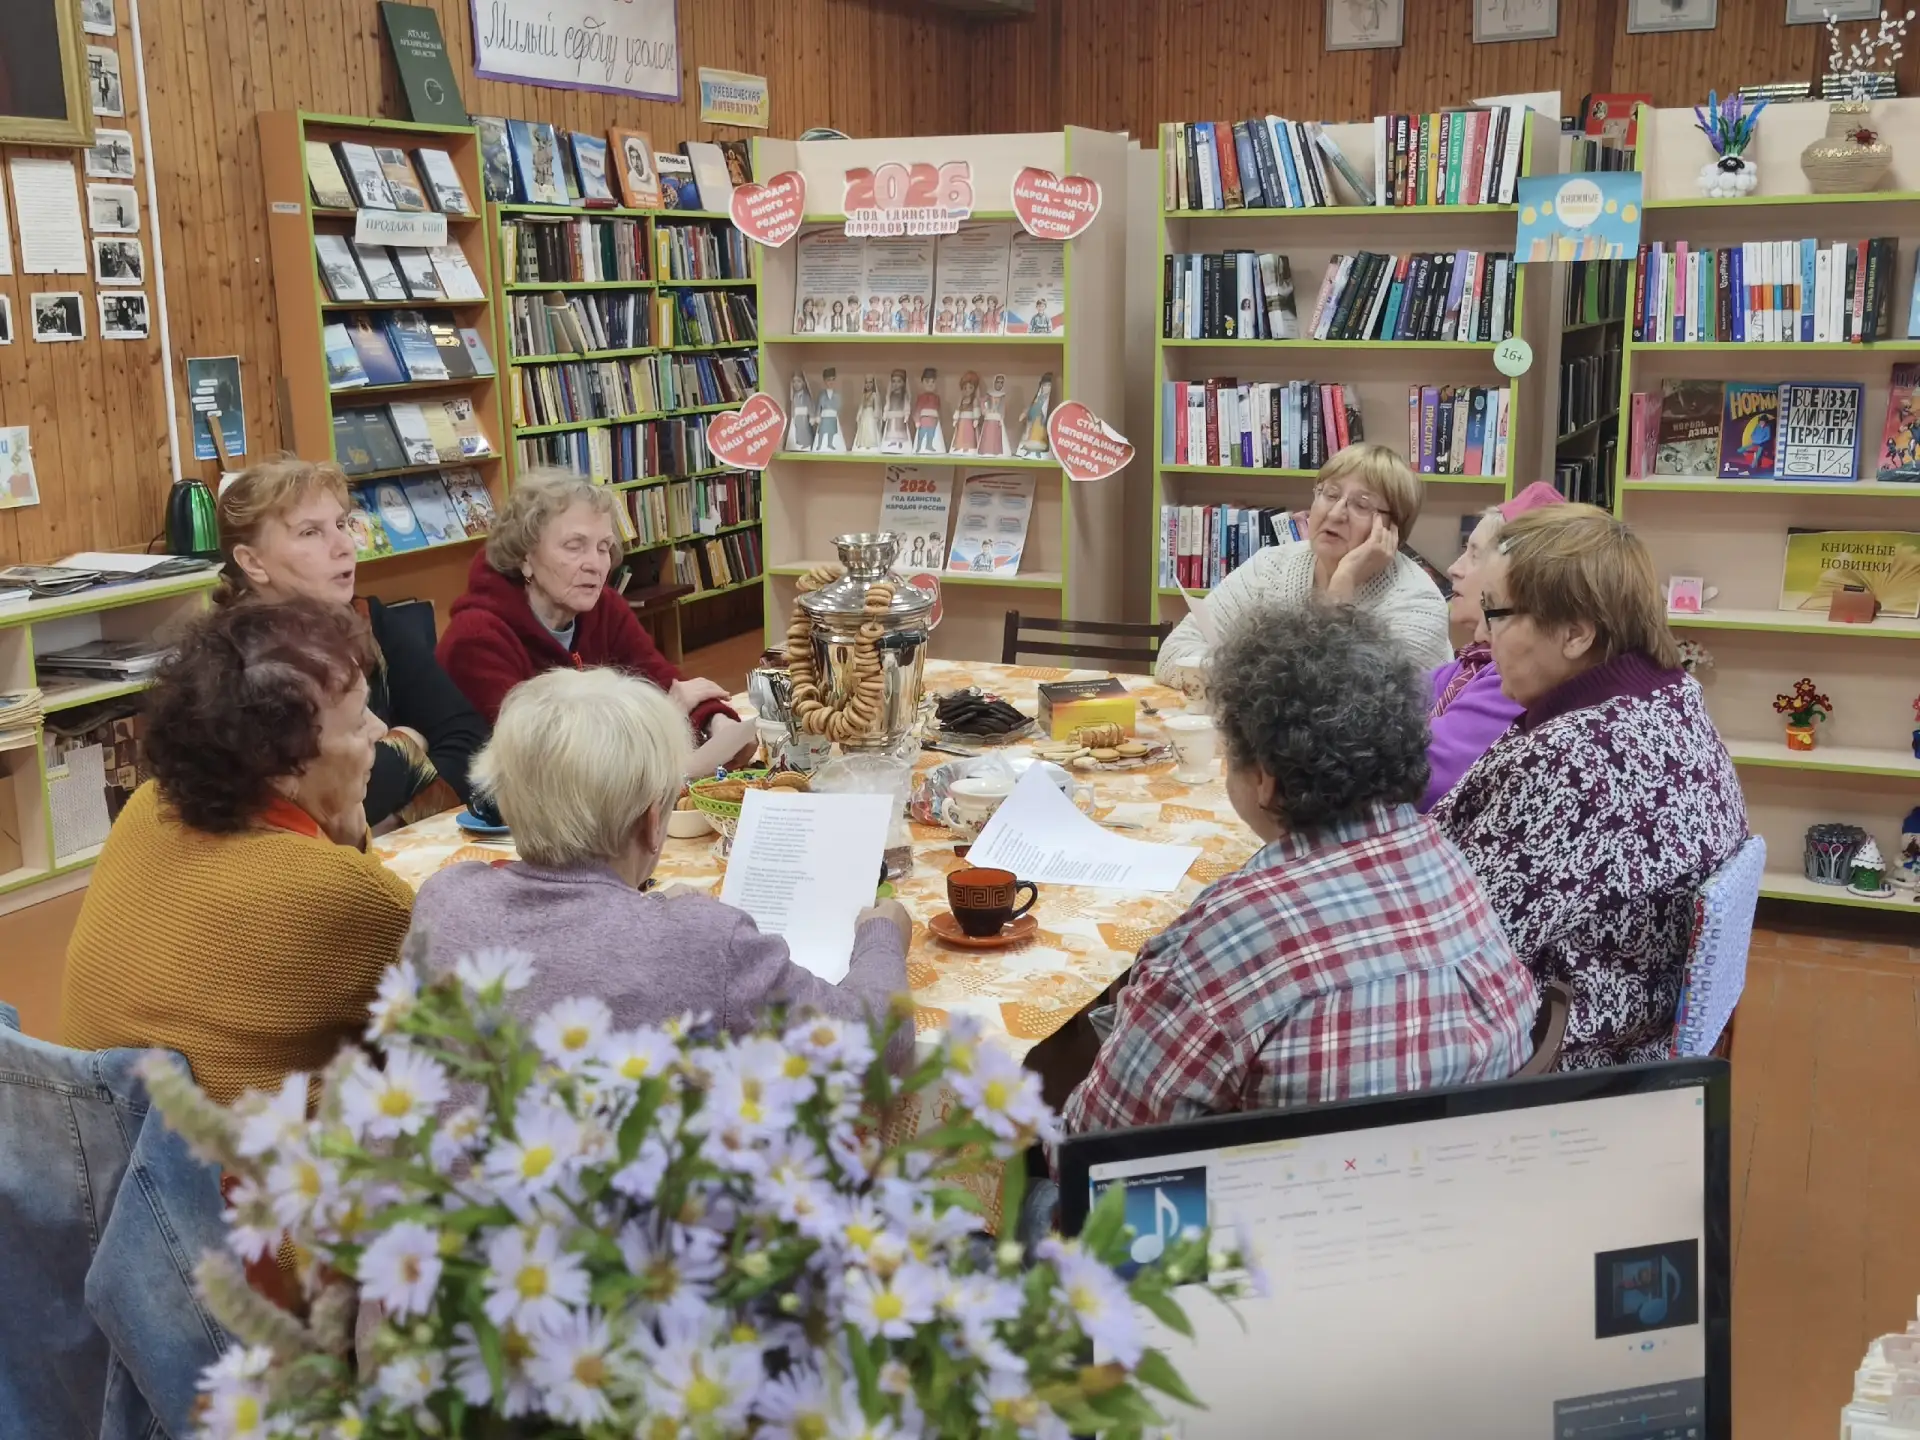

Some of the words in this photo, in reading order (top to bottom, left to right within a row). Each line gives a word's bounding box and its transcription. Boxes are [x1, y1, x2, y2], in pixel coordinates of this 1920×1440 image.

[484, 0, 558, 57] Милый
[564, 16, 618, 82] сердцу
[625, 36, 675, 83] уголок
[1397, 120, 1407, 152] ПЕТЛЯ
[1420, 121, 1429, 147] ОЛЕГ
[1441, 116, 1449, 141] ТРАУБ
[1453, 116, 1462, 140] ТРАУБ
[1409, 128, 1418, 150] ДЕНЬ
[1420, 148, 1428, 171] РОЙ
[1439, 142, 1448, 166] МАША
[1451, 141, 1460, 165] МАША
[1407, 151, 1417, 188] СЧАСТЬЯ
[746, 182, 791, 206] НАРОДОВ
[845, 161, 972, 211] 2026
[1034, 178, 1082, 196] КАЖДЫЙ
[751, 199, 783, 218] МНОГО
[1015, 187, 1050, 204] НАРОД
[1063, 197, 1096, 213] ЧАСТЬ
[1560, 193, 1599, 205] КНИЖНЫЕ
[755, 208, 796, 229] РОДИНА
[857, 209, 878, 221] ГОД
[886, 208, 948, 220] ЕДИНСТВА
[1031, 204, 1076, 222] ВЕЛИКОЙ
[366, 218, 415, 232] ПРОДАЖА
[767, 222, 795, 239] ОДНА
[847, 222, 903, 234] НАРОДОВ
[909, 221, 957, 233] РОССИИ
[1030, 217, 1071, 233] РОССИИ
[1502, 347, 1524, 362] 16+
[720, 411, 759, 438] РОССИЯ
[1790, 408, 1856, 427] МИСТЕРА
[720, 435, 744, 454] НАШ
[745, 411, 781, 439] ОБЩИЙ
[1423, 405, 1434, 457] ПРИСЛУГА
[1688, 425, 1720, 438] ДЗЮДО
[1788, 426, 1854, 446] ТЕРРАПТА
[746, 436, 768, 456] ДОМ
[1057, 437, 1088, 455] КОГДА
[1090, 450, 1117, 467] ЕДИН
[1066, 454, 1099, 474] НАРОД
[899, 479, 937, 493] 2026
[885, 503, 917, 511] НАРОДОВ
[918, 503, 946, 512] РОССИИ
[906, 495, 942, 503] ЕДИНСТВА
[1821, 542, 1897, 556] КНИЖНЫЕ
[1821, 558, 1892, 573] НОВИНКИ
